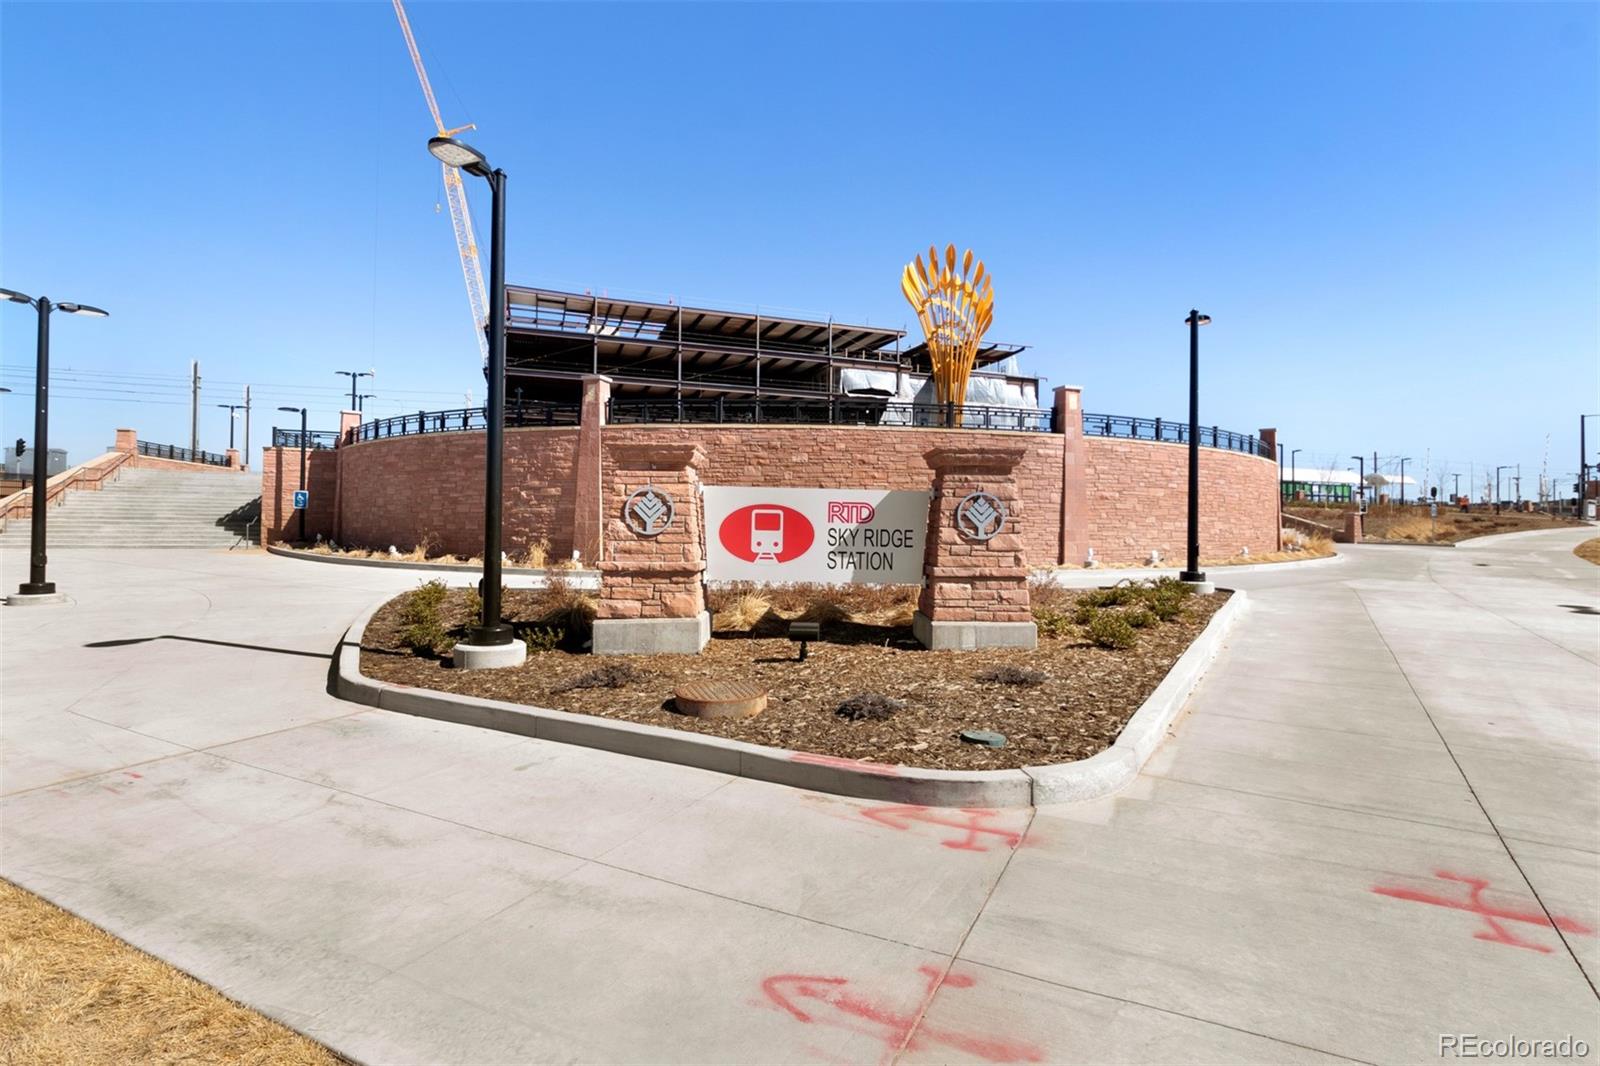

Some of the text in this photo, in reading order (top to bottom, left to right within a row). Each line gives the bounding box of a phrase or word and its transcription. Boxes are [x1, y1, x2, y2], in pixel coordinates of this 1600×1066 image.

[828, 501, 875, 523] RTD
[827, 528, 914, 548] SKY RIDGE
[827, 551, 894, 570] STATION
